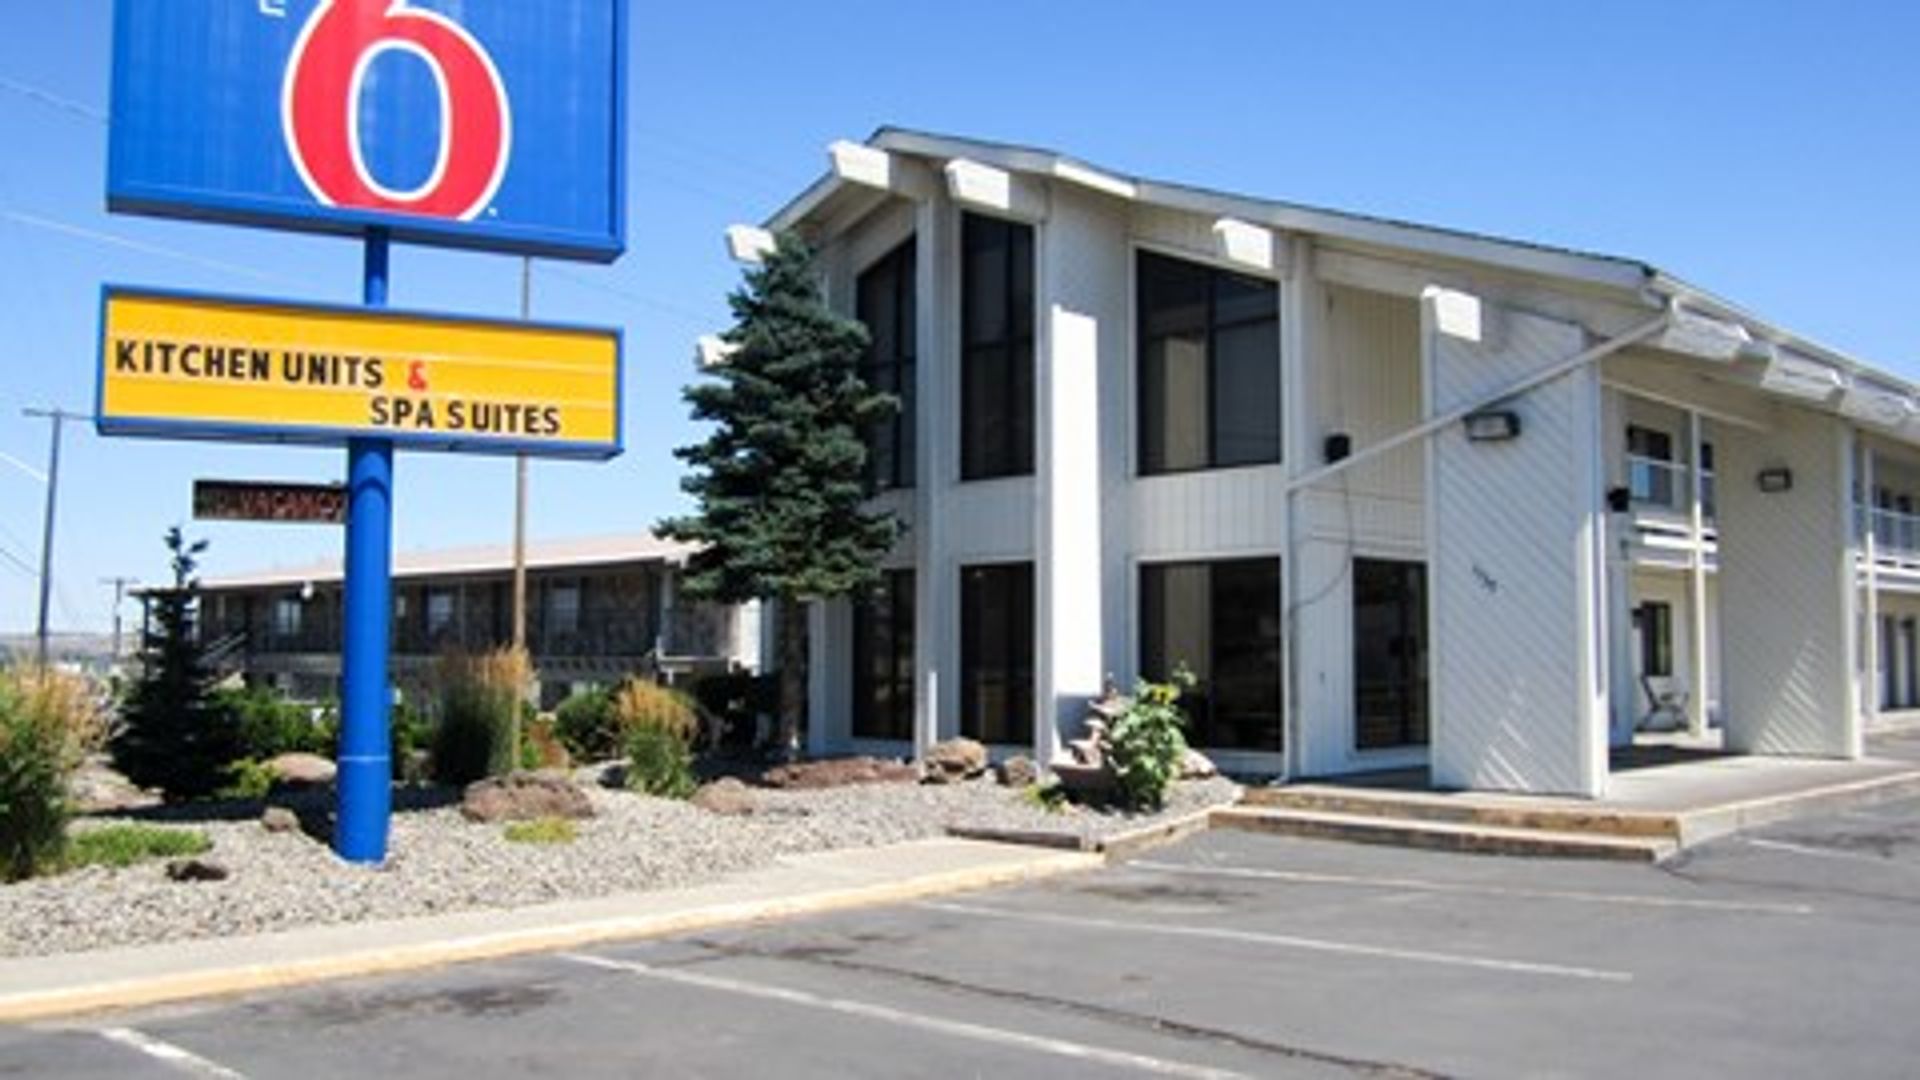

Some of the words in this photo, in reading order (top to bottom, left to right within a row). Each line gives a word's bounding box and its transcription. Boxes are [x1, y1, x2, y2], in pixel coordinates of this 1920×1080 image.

[281, 0, 511, 221] 6
[115, 341, 270, 381] KITCHEN
[283, 353, 383, 388] UNITS
[407, 360, 428, 390] &
[371, 396, 434, 427] SPA
[447, 400, 561, 434] SUITES
